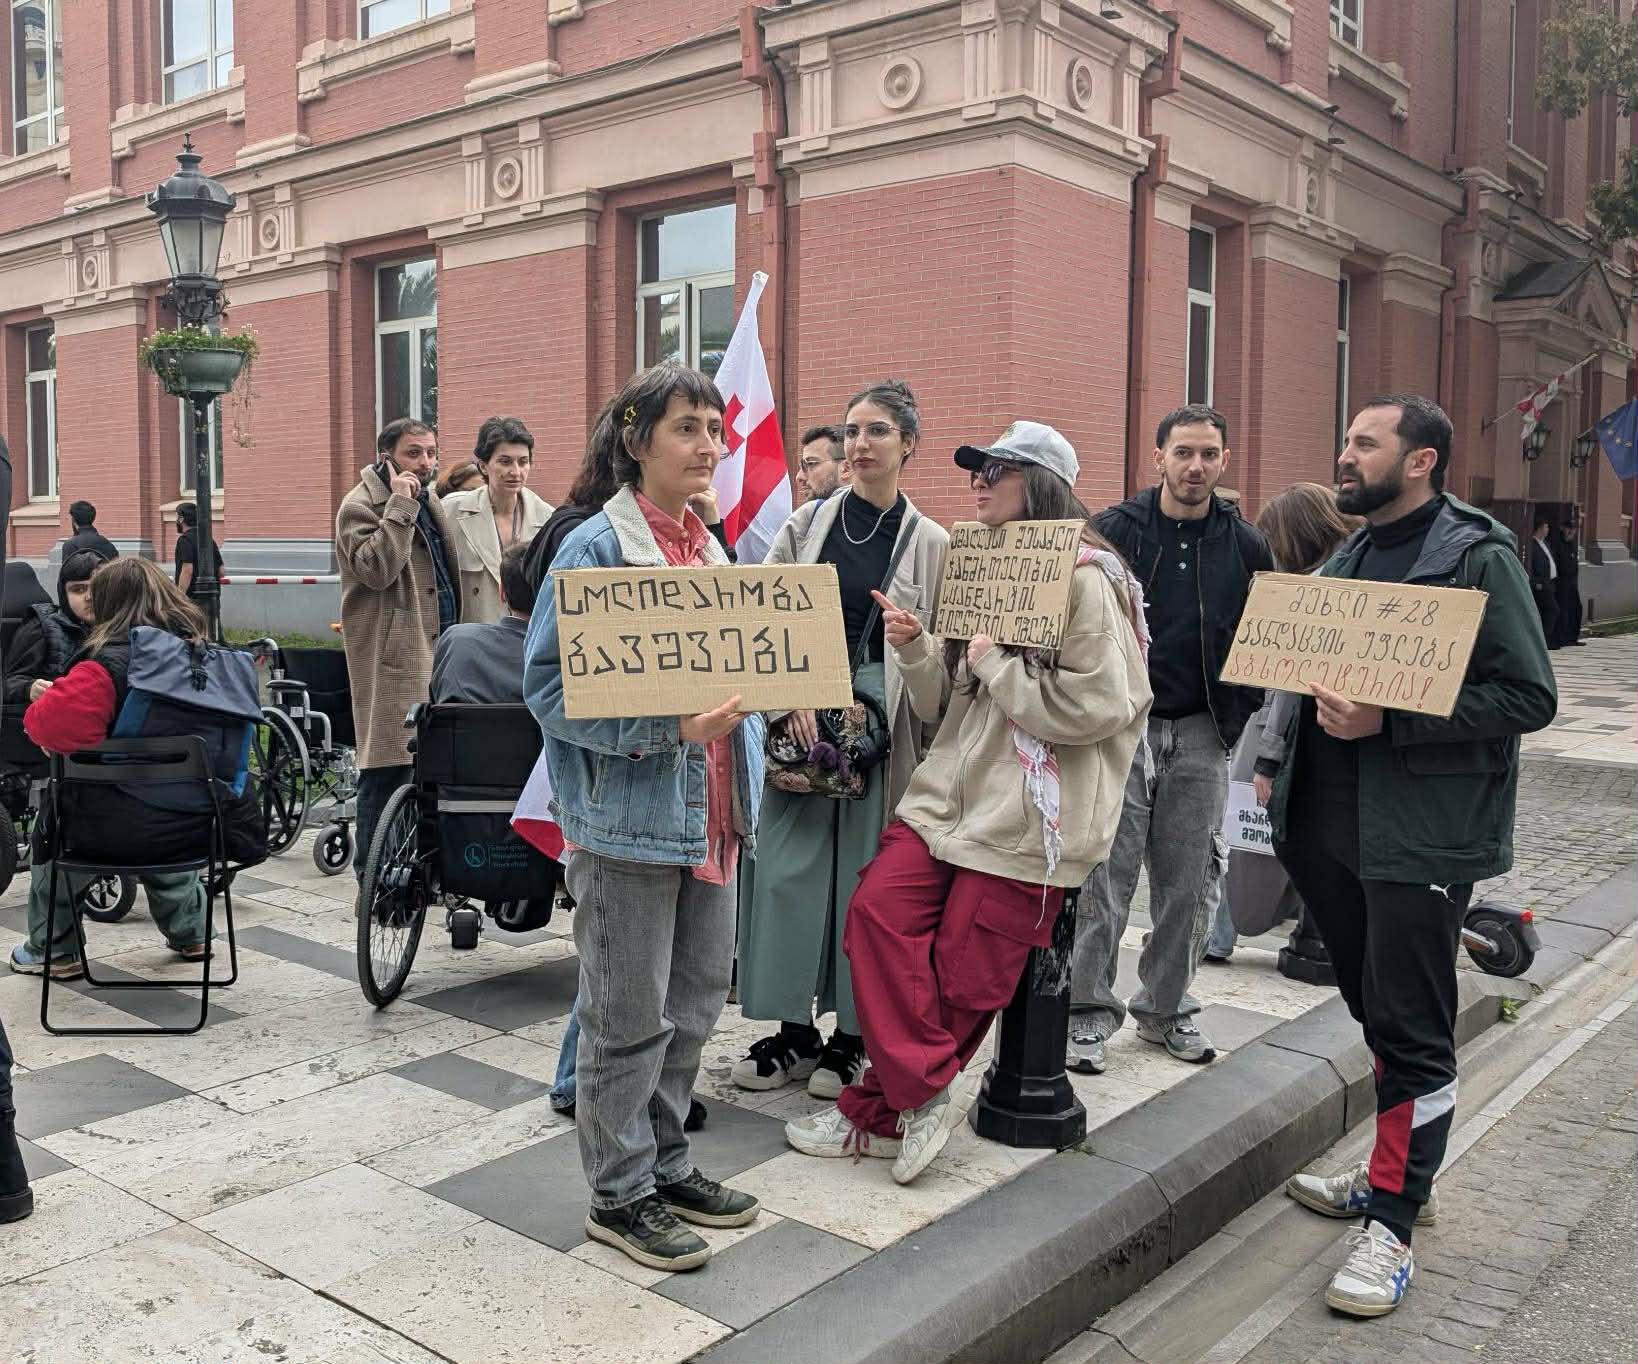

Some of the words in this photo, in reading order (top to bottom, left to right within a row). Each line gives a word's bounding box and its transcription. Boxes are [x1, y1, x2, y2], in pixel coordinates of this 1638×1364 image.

[950, 527, 1007, 551] უმაღლესი
[1015, 525, 1077, 552] შესაძლო
[946, 554, 1062, 584] ჯანმრთელობის
[559, 575, 814, 615] სოლიდარობა
[942, 583, 1036, 613] სტანდარტის
[1288, 584, 1369, 619] მუხლი
[1376, 596, 1440, 627] #28
[567, 626, 810, 676] ბავშვებს
[1012, 613, 1063, 649] უფლება
[1237, 616, 1347, 656] ჯანდაცვის
[1356, 630, 1457, 672] უფლება
[1229, 652, 1435, 710] აბსოლუტურია!
